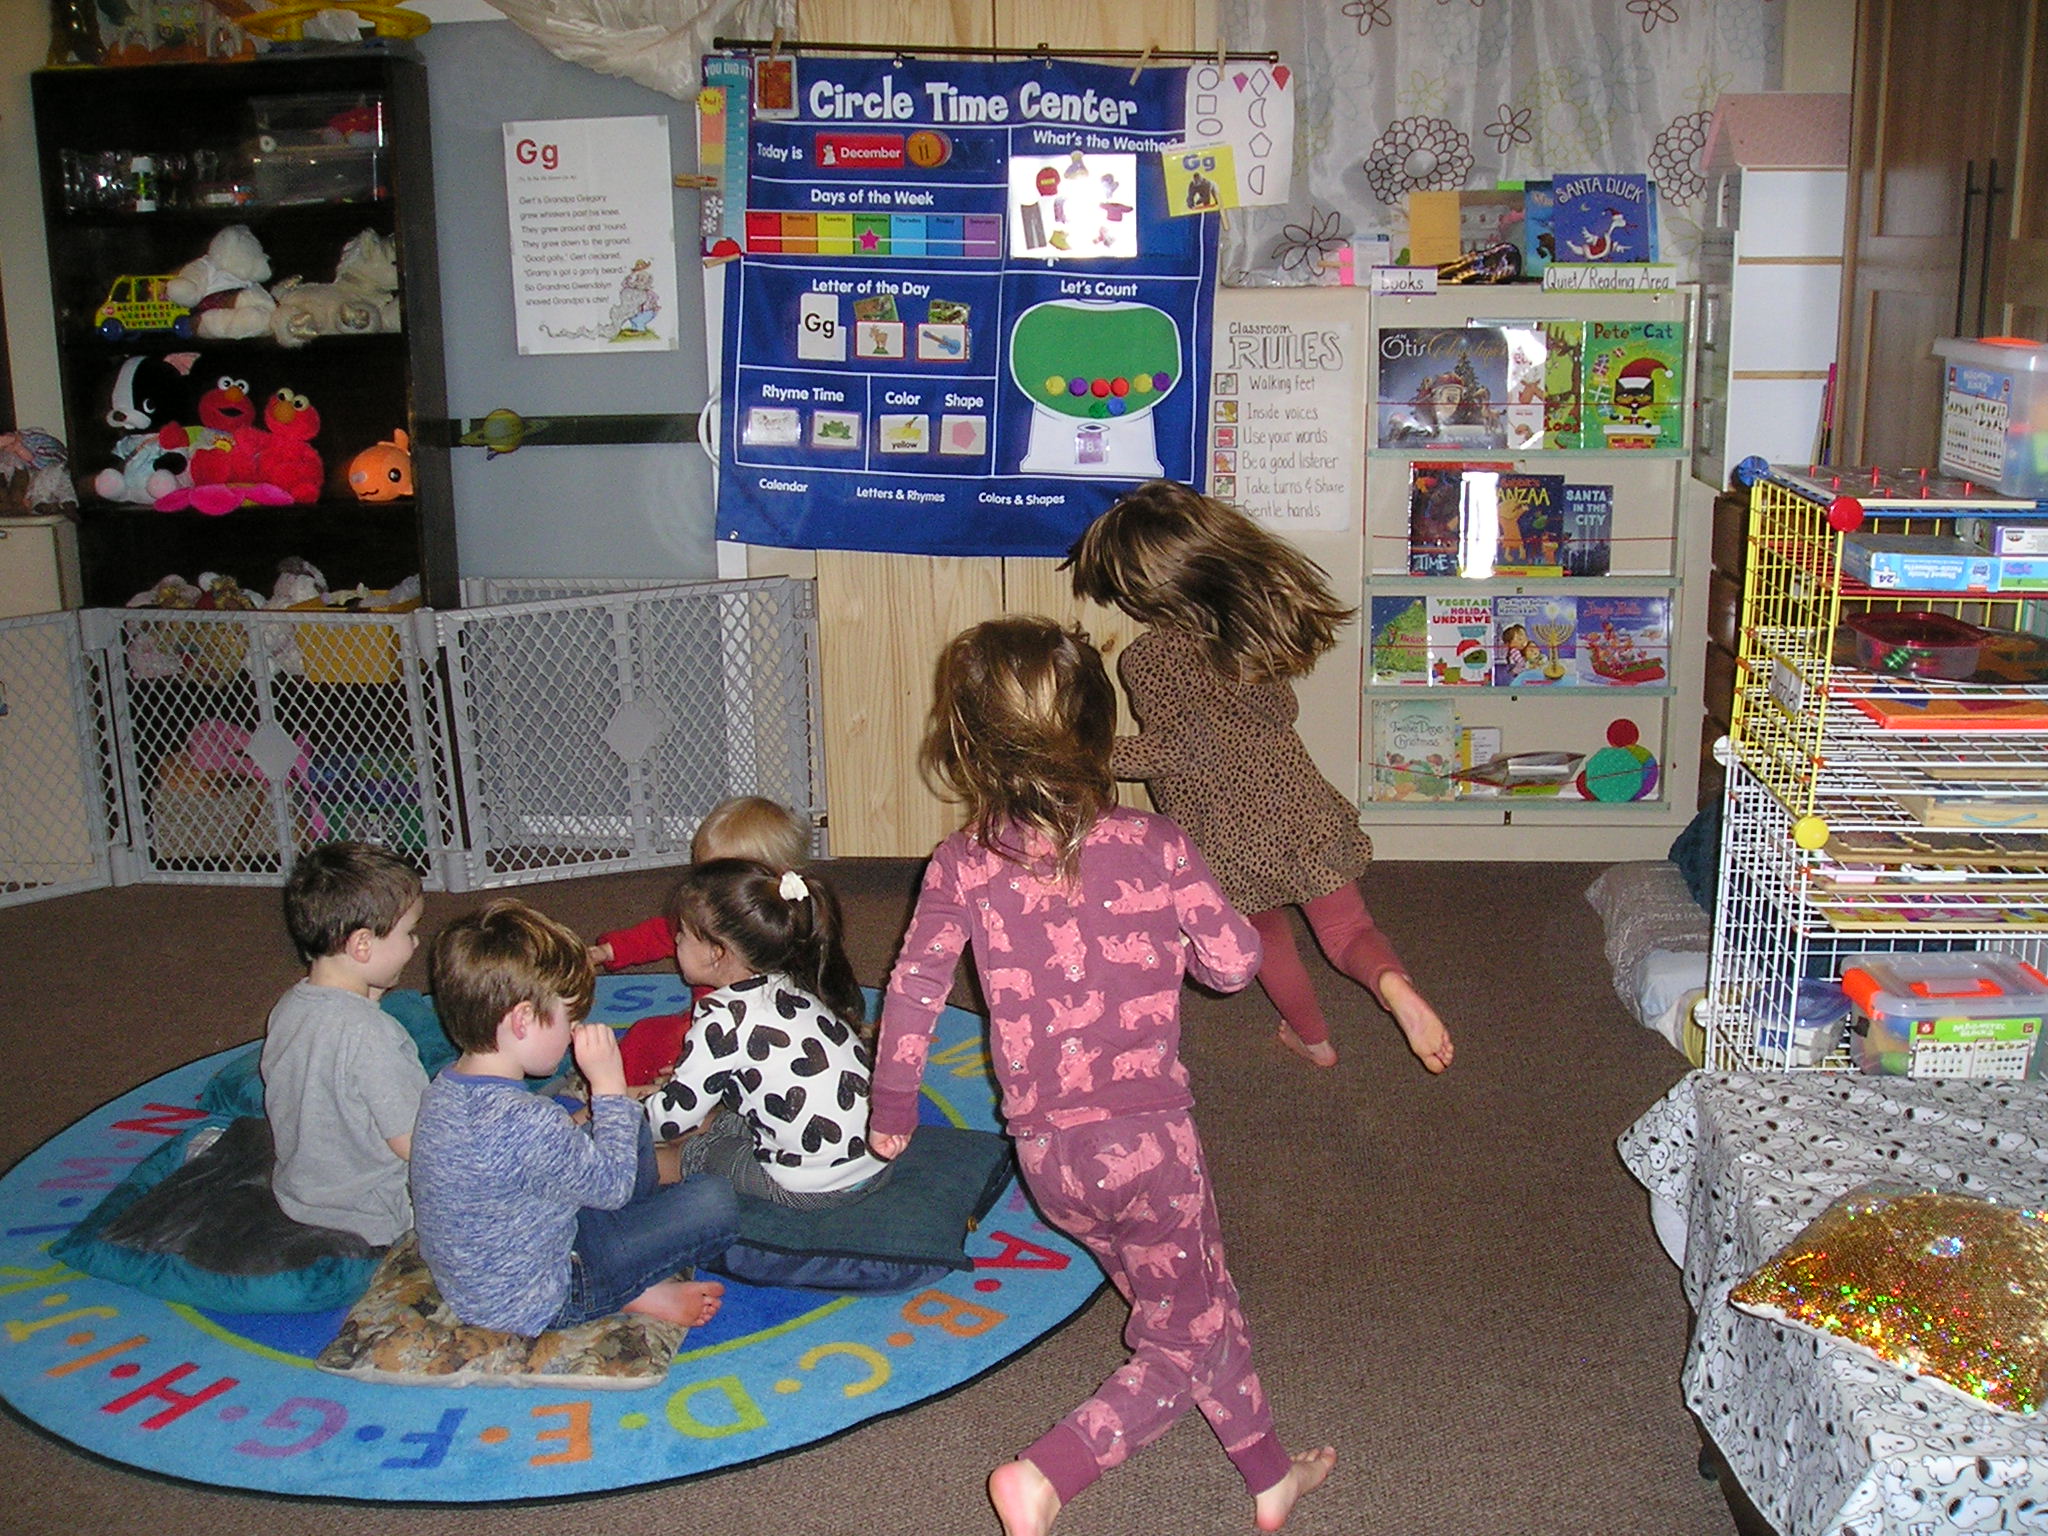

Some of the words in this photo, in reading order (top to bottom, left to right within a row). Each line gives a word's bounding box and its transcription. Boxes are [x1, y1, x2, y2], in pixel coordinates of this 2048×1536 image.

[809, 74, 914, 120] Circle
[925, 81, 1009, 123] Time
[1019, 80, 1138, 126] Center
[1033, 130, 1083, 147] What's
[1086, 134, 1110, 150] the
[516, 139, 559, 170] Gg
[757, 142, 788, 163] Today
[791, 145, 803, 160] is
[840, 146, 901, 159] December
[1183, 154, 1216, 171] Gg
[811, 189, 846, 205] Days
[849, 188, 865, 202] of
[868, 190, 892, 204] the
[894, 191, 935, 205] Week
[1555, 177, 1602, 203] SANTA
[1606, 177, 1644, 204] DUCK
[1639, 267, 1670, 289] Area
[812, 278, 853, 294] Letter
[856, 279, 873, 293] of
[876, 280, 900, 295] the
[903, 281, 931, 298] Day
[1060, 280, 1092, 295] Let's
[1095, 282, 1138, 296] Count
[804, 312, 836, 339] Gg
[1229, 322, 1292, 335] Classroom
[1594, 322, 1630, 339] Pete
[1644, 323, 1673, 339] Cat
[1228, 331, 1343, 371] RULES
[1381, 335, 1427, 359] Otis
[762, 384, 809, 403] Rhyme
[812, 387, 845, 403] Time
[1249, 374, 1292, 395] Walking
[885, 391, 921, 406] Color
[945, 394, 984, 410] Shape
[1247, 402, 1280, 420] Inside
[1285, 406, 1319, 420] voices
[892, 441, 919, 450] yellow
[1243, 426, 1267, 444] Use
[1268, 431, 1292, 452] your
[1295, 427, 1328, 444] words
[1269, 451, 1296, 475] good
[1299, 450, 1339, 470] listener
[758, 477, 809, 493] Calendar
[1244, 476, 1270, 494] Take
[1273, 475, 1303, 494] turns
[856, 486, 894, 500] Letters
[895, 488, 905, 501] &
[906, 489, 946, 504] Rhymes
[978, 492, 1012, 504] Colors
[1013, 493, 1024, 505] &
[1026, 493, 1066, 507] Shapes
[1566, 489, 1607, 501] SANTA
[1287, 499, 1321, 518] hands
[1573, 503, 1582, 513] IN
[1585, 503, 1607, 513] THE
[1575, 514, 1607, 527] CITY
[1878, 573, 1895, 584] 24
[1433, 615, 1491, 624] UNDERWE
[971, 1230, 1072, 1270] A
[902, 1289, 1009, 1338] B
[800, 1342, 892, 1399] C
[100, 1362, 241, 1431] H
[665, 1374, 769, 1440] D
[232, 1396, 349, 1459] G
[529, 1400, 594, 1467] E
[380, 1407, 469, 1470] F
